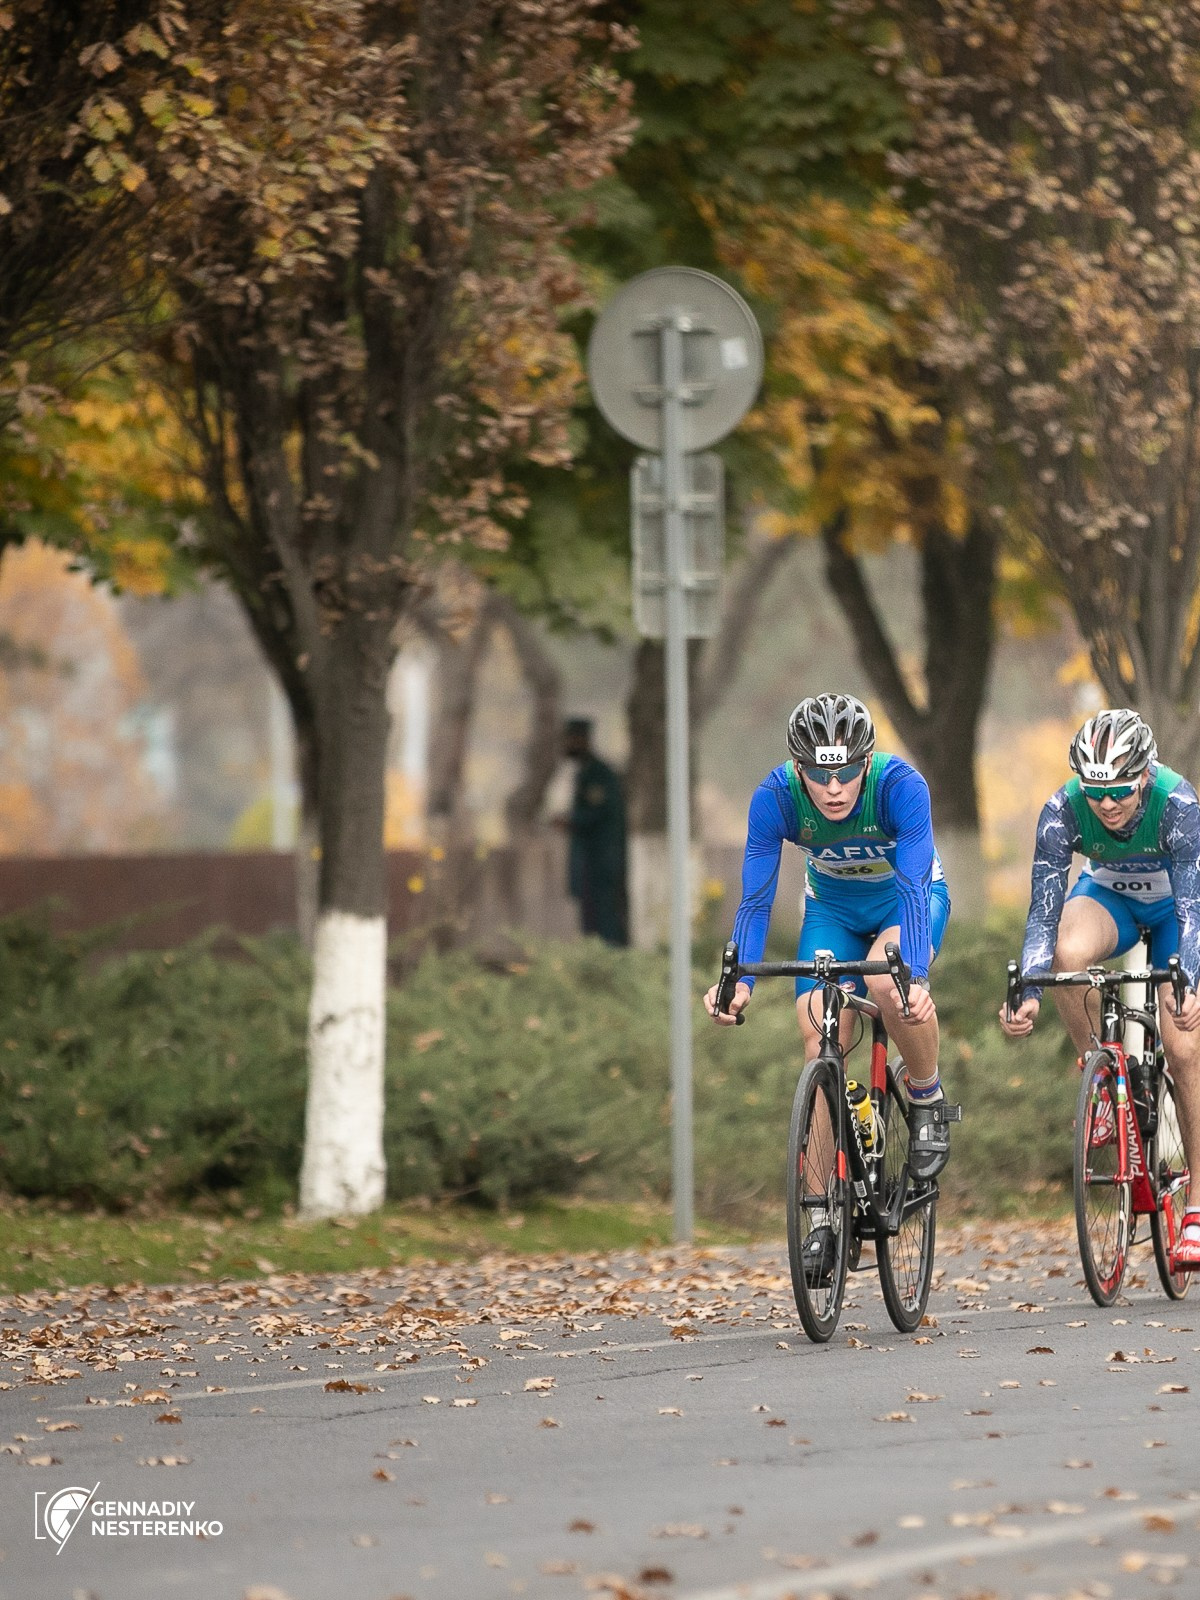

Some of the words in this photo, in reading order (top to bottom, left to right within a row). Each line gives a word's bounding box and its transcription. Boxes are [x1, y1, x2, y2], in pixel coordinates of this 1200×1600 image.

[820, 753, 843, 762] 036
[1090, 770, 1109, 779] 001
[1112, 881, 1153, 891] 001
